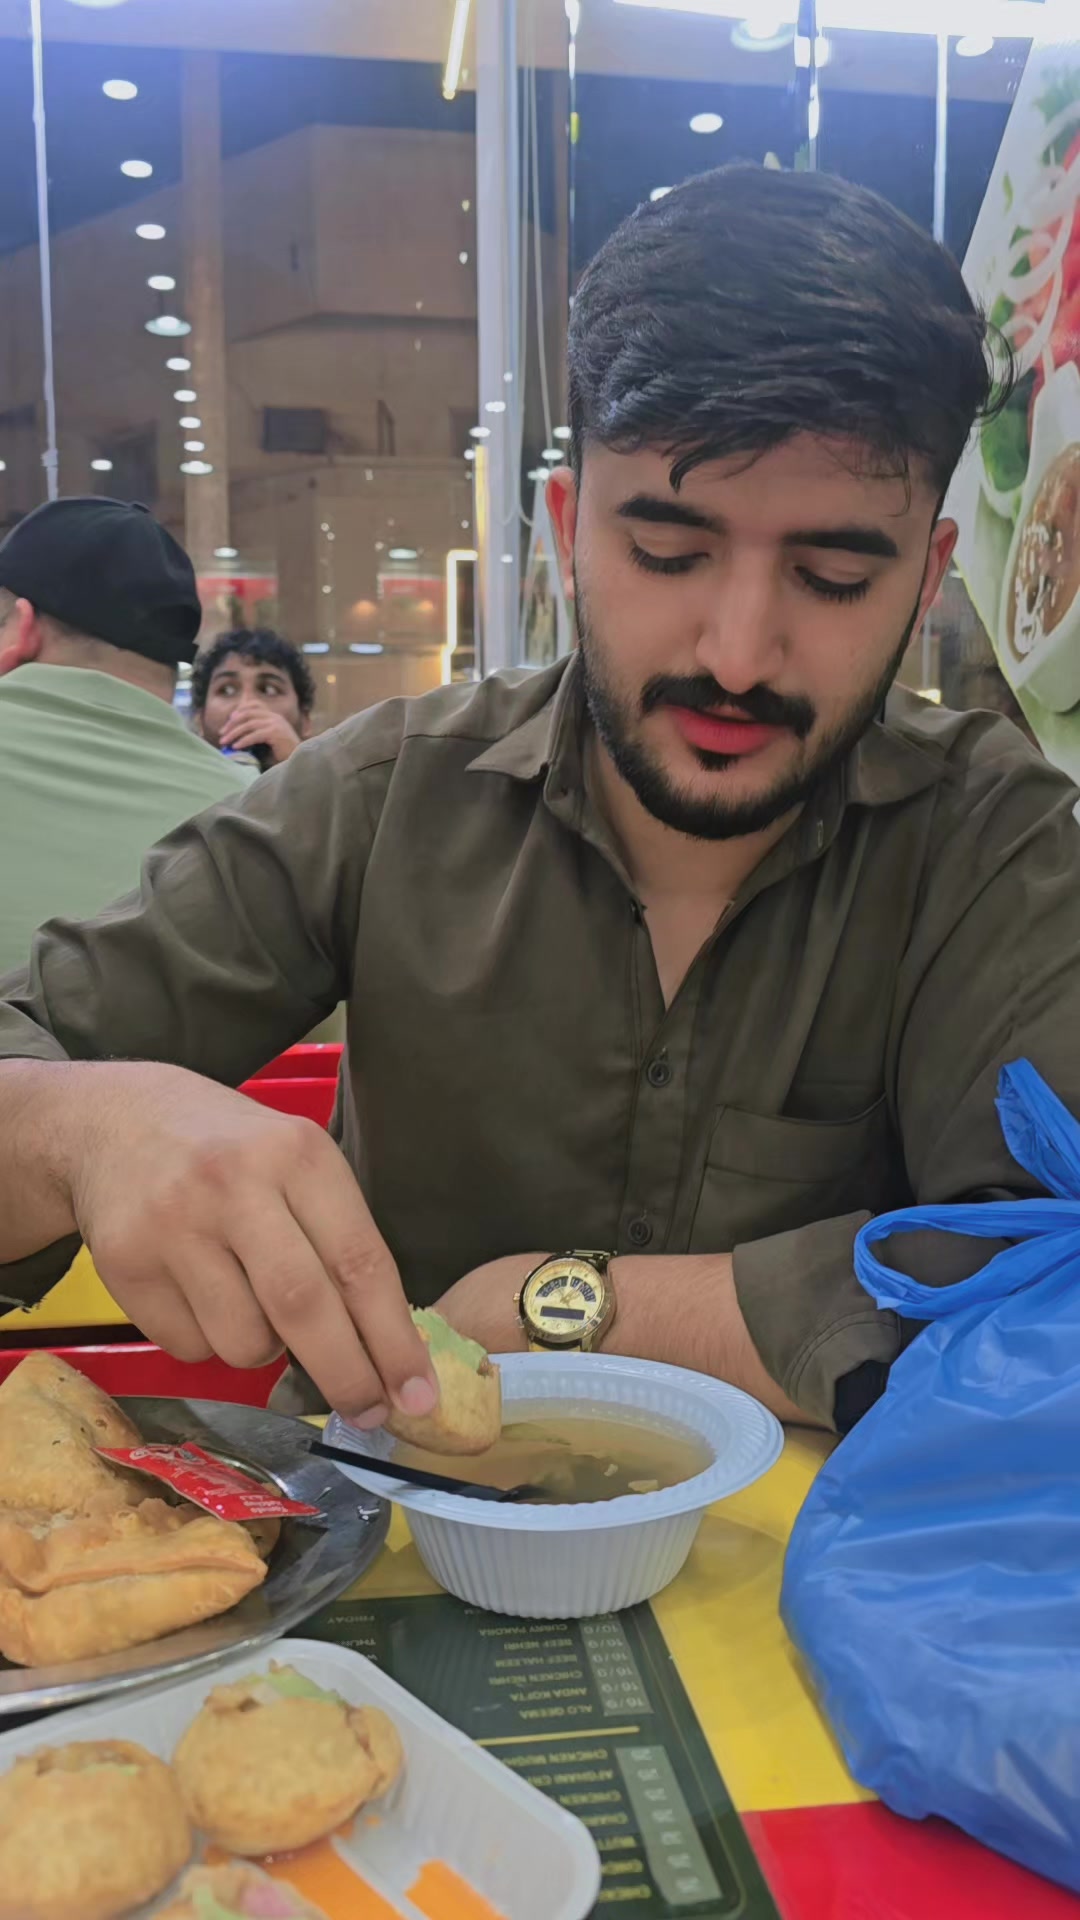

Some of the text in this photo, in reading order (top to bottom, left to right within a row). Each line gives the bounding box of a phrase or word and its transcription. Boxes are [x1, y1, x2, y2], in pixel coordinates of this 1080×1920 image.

[327, 1616, 374, 1624] FRIDAY
[479, 1626, 526, 1636] PAKORA
[529, 1622, 567, 1632] CURRY
[544, 1638, 572, 1647] BEEF
[495, 1657, 544, 1667] HALEEM
[547, 1654, 577, 1664] BEEF
[528, 1670, 583, 1683] CHICKEN
[509, 1691, 550, 1702] KOFTA
[552, 1688, 587, 1699] ANDA
[519, 1707, 565, 1719] QEEMA
[567, 1704, 592, 1714] ALO
[549, 1749, 608, 1764] CHICKEN
[554, 1769, 613, 1784] AFGHANI
[561, 1789, 621, 1806] CHICKEN
